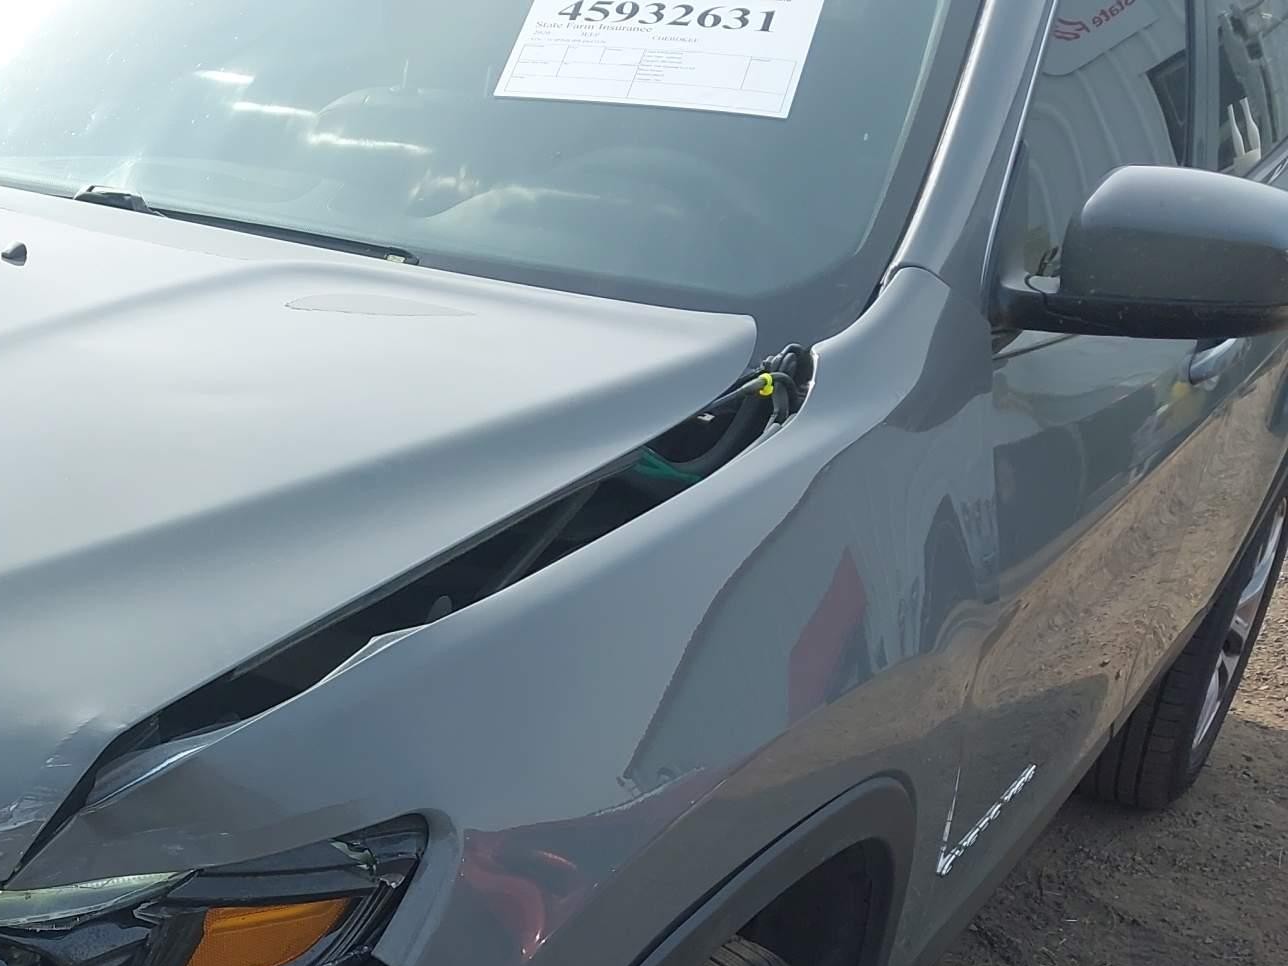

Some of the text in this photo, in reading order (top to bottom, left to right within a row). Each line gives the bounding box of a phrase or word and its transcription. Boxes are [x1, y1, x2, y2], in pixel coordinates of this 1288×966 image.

[536, 20, 653, 33] State Farm Insurance
[558, 0, 776, 33] 45932631
